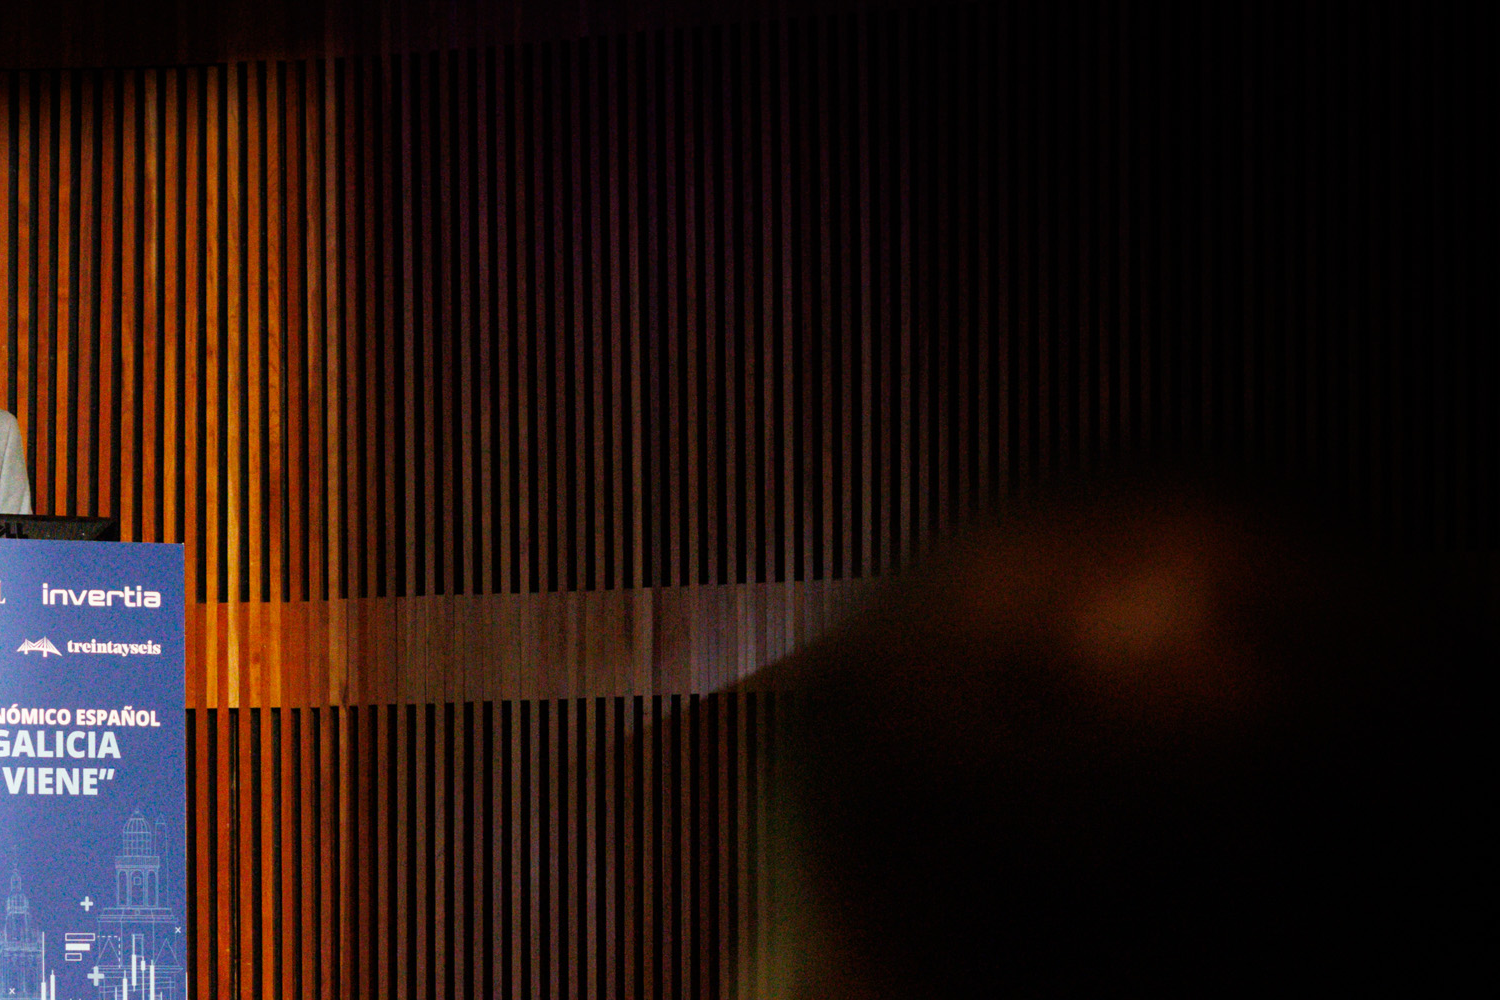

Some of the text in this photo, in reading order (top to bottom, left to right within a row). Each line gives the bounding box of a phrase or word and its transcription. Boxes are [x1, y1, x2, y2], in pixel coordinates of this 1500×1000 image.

[42, 583, 161, 608] invertia
[67, 639, 162, 657] treintayseis
[76, 705, 161, 727] ESPAÑOL
